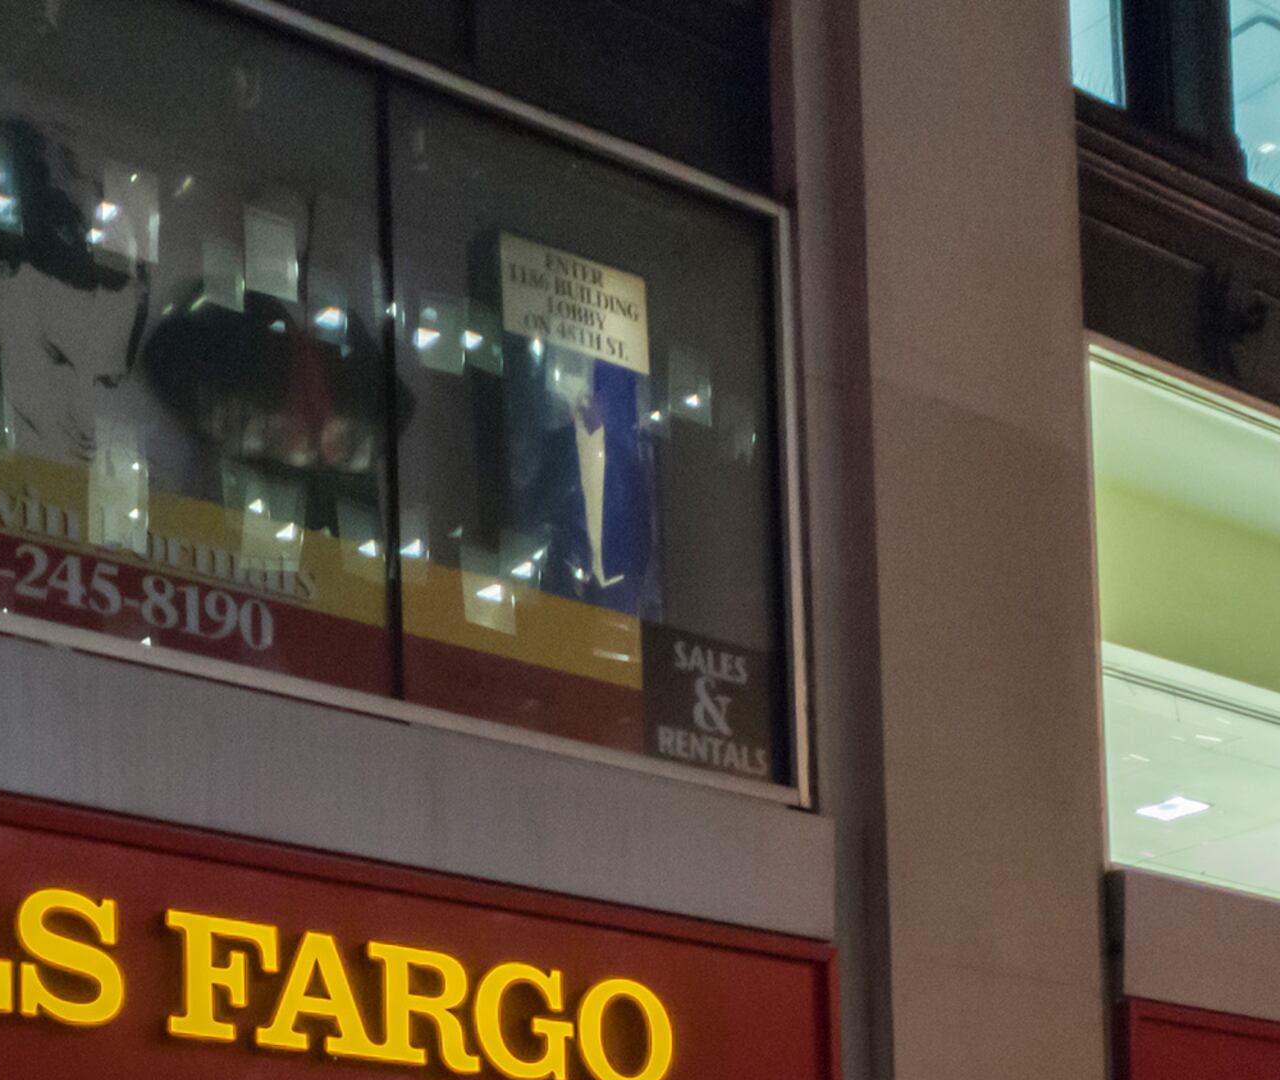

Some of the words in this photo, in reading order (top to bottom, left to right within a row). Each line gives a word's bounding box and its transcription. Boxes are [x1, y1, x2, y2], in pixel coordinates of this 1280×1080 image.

[545, 252, 603, 288] ENTER
[548, 297, 605, 330] LOBBY
[555, 276, 639, 321] BUILDING
[524, 313, 553, 336] ON
[674, 640, 748, 685] SALES
[693, 675, 733, 736] &
[658, 725, 768, 776] RENTALS
